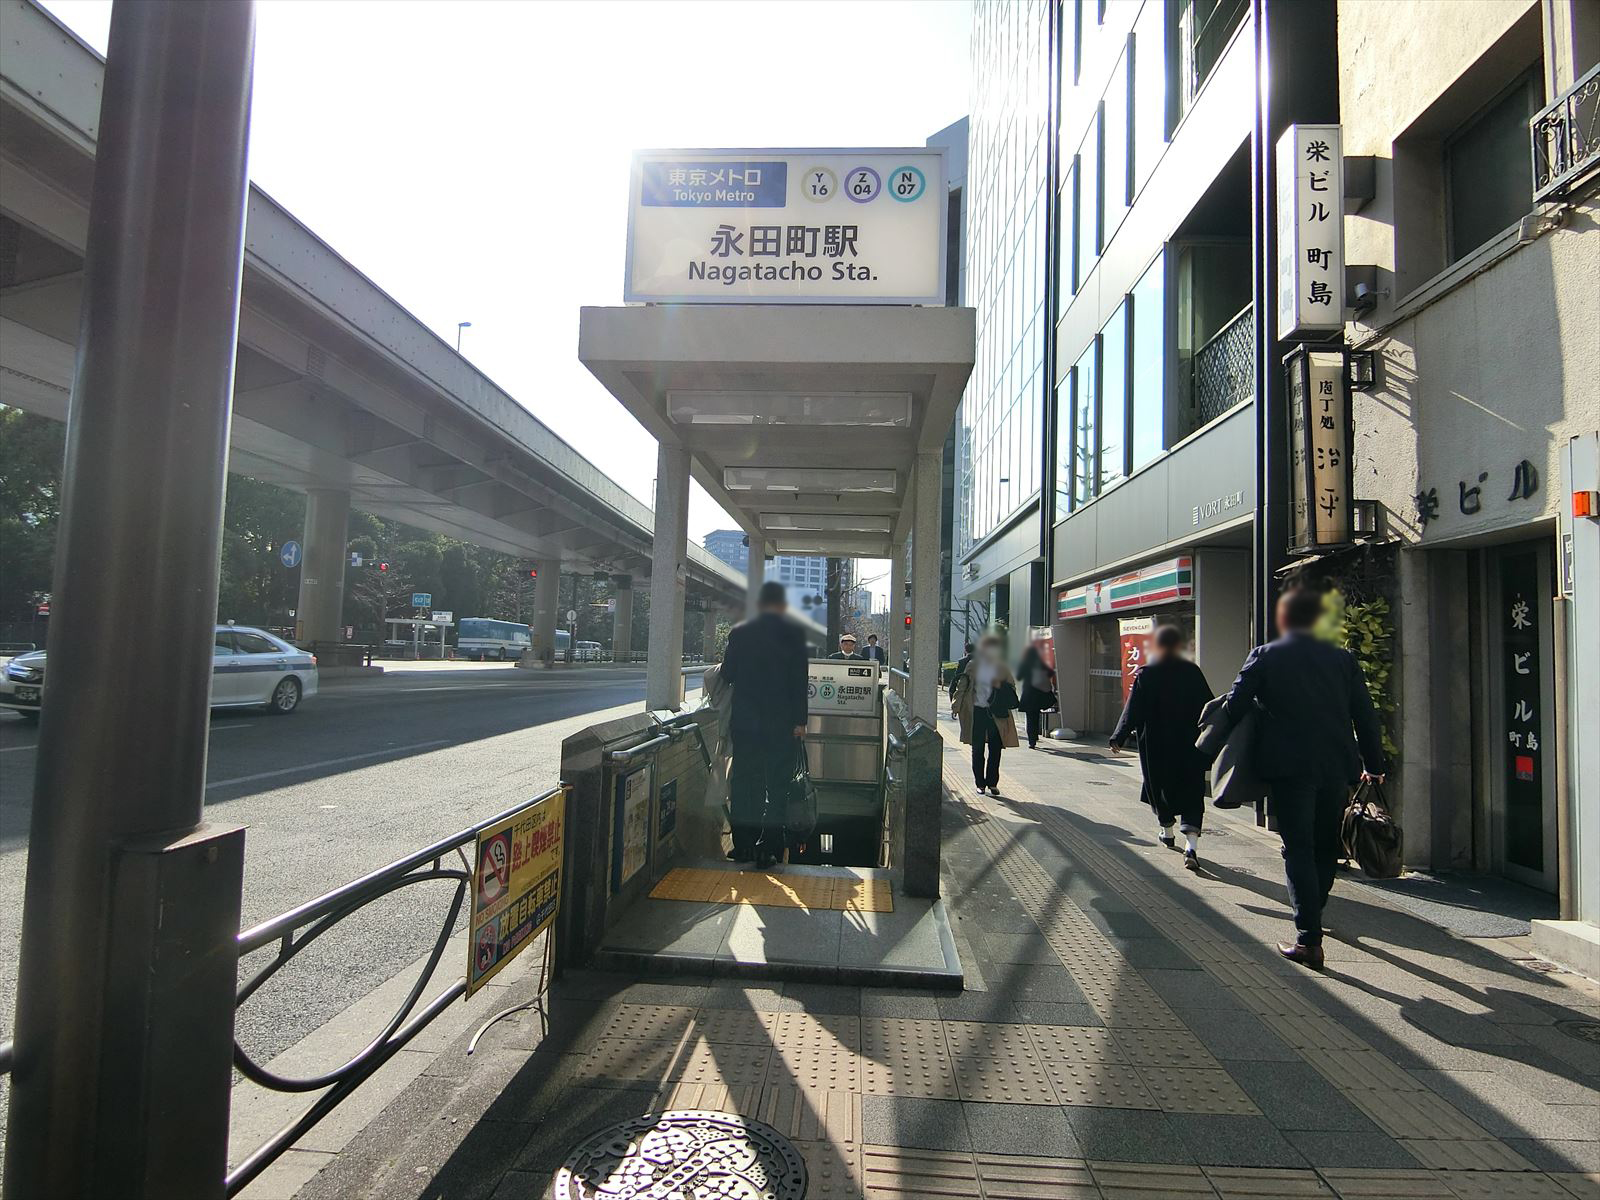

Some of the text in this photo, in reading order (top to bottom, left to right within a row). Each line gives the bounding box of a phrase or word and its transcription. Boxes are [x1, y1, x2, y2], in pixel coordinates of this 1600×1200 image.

[668, 168, 762, 187] 東京メトロ
[815, 173, 823, 183] Y
[859, 173, 867, 183] Z
[902, 172, 912, 183] N
[673, 189, 755, 205] Tokyo Metro
[811, 184, 828, 196] 16
[853, 184, 872, 196] 04
[897, 184, 916, 195] 07
[1306, 140, 1333, 306] 栄ビル 町島
[710, 225, 858, 258] 永田町駅
[689, 261, 878, 286] Nagatacho Sta.
[1200, 498, 1223, 520] VORT
[1511, 600, 1533, 722] 栄ビル
[838, 686, 872, 695] 永田町駅
[1509, 731, 1539, 751] 町島
